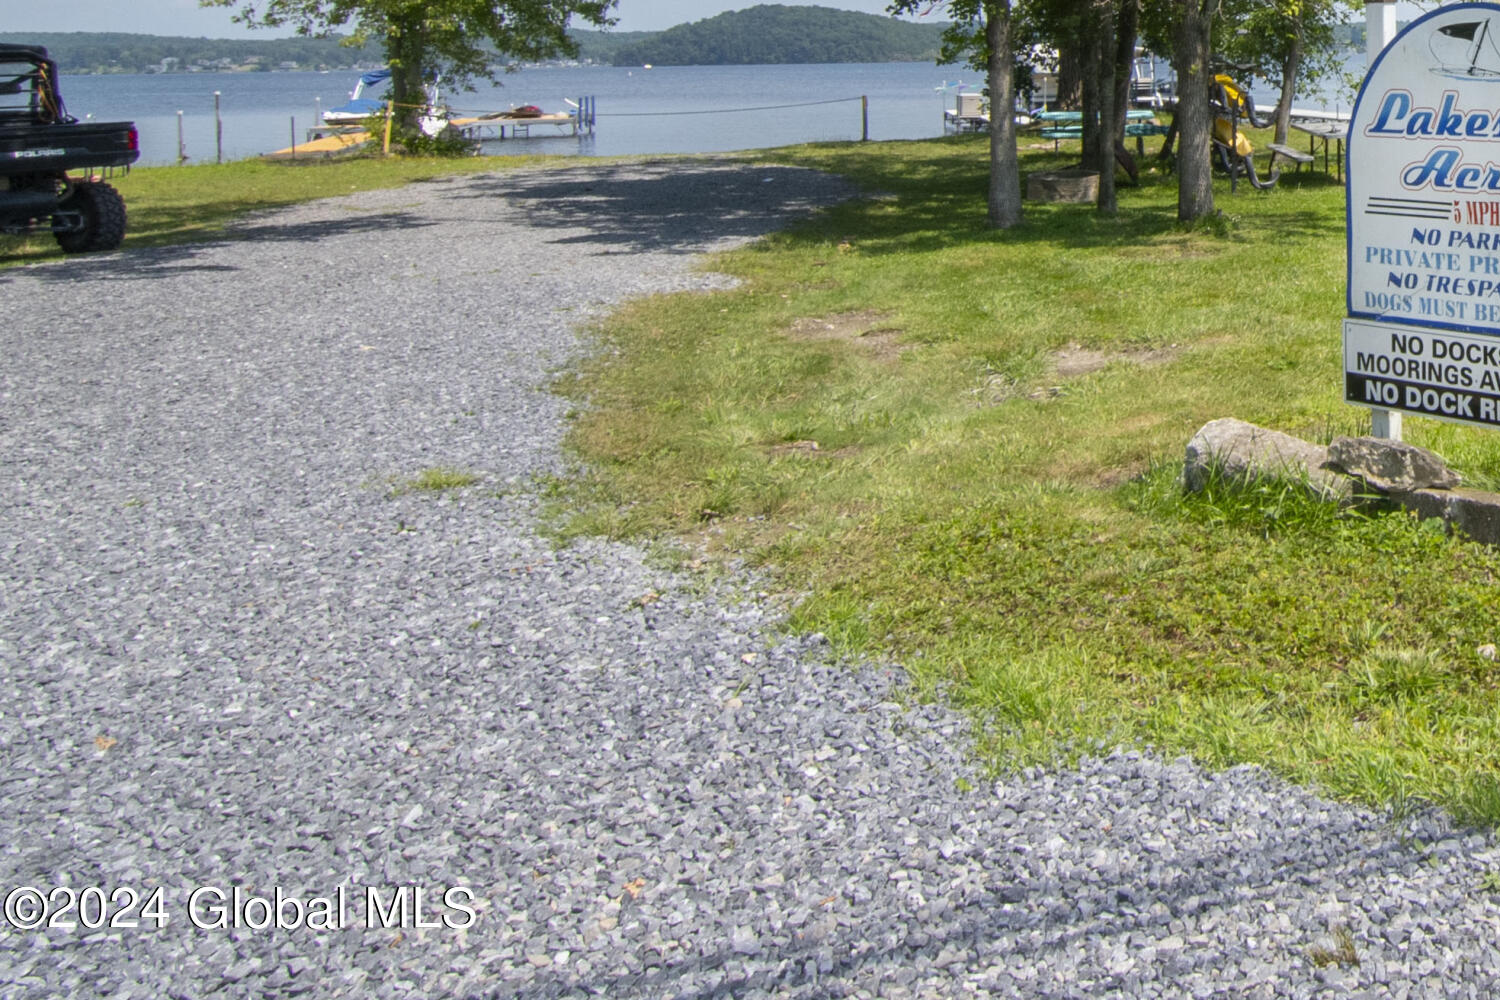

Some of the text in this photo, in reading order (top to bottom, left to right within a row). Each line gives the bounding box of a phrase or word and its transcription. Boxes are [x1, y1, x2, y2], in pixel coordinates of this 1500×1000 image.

[14, 148, 65, 158] POLARIS
[1454, 201, 1500, 226] 5 MPH
[1411, 228, 1441, 246] NO
[1365, 246, 1460, 271] PRIVATE
[1387, 272, 1418, 289] NO
[1365, 291, 1412, 313] DOGS
[1418, 297, 1467, 319] MUST
[1475, 305, 1500, 323] BE
[1391, 334, 1423, 355] NO
[1357, 352, 1472, 386] MOORINGS
[1365, 381, 1399, 404] NO
[1405, 386, 1474, 418] DOCK
